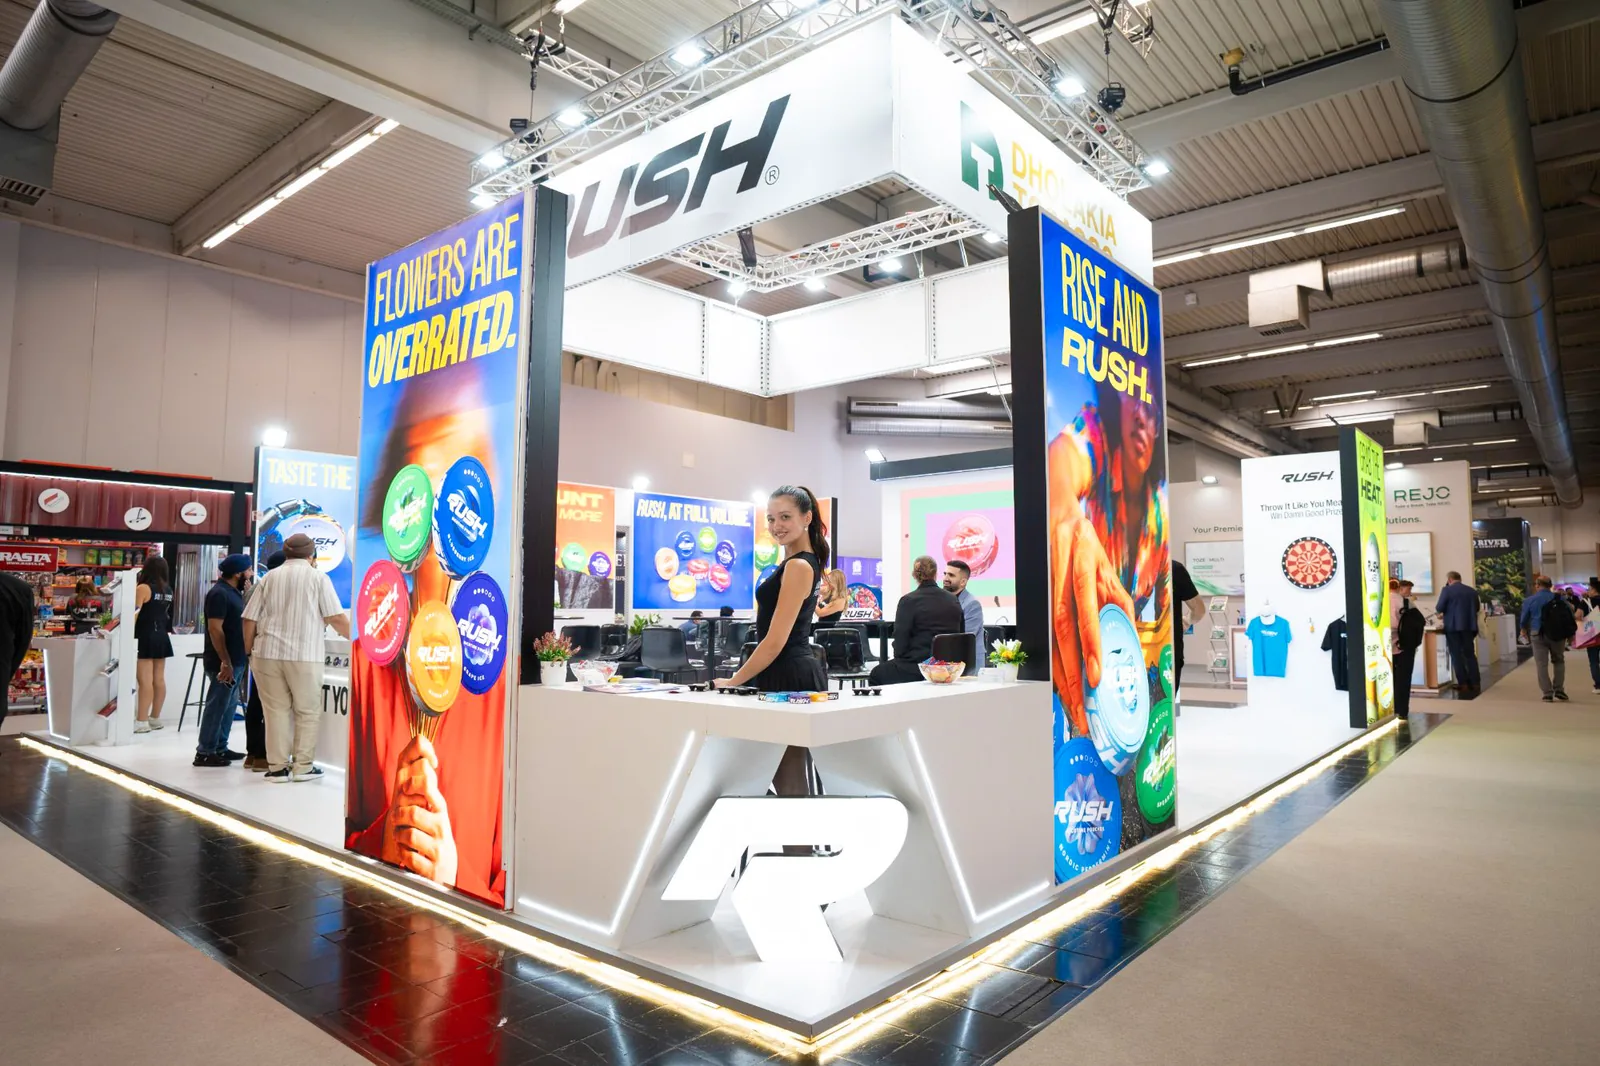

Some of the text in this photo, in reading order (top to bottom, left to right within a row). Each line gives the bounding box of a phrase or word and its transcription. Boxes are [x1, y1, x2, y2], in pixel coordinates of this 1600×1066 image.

[567, 94, 793, 259] USH
[374, 213, 520, 326] FLOWERS ARE
[1061, 242, 1149, 357] RISE AND
[368, 290, 517, 388] OVERRATED.
[1061, 326, 1153, 404] RUSH.
[266, 458, 354, 490] TASTE THE
[1260, 504, 1283, 512] Throw
[1292, 502, 1308, 510] Like
[1394, 486, 1450, 502] REJO
[447, 493, 488, 536] RUSH
[560, 508, 603, 522] MORE
[636, 499, 668, 522] RUSH,
[669, 502, 683, 520] AT
[684, 504, 709, 524] FULL
[1284, 511, 1304, 519] Damn
[1305, 510, 1324, 518] Good
[312, 537, 338, 546] SH
[1192, 526, 1211, 534] Your
[458, 618, 502, 652] RUSH
[417, 646, 457, 663] RUSH
[1143, 737, 1174, 784] RUS
[1054, 801, 1114, 824] RUSH
